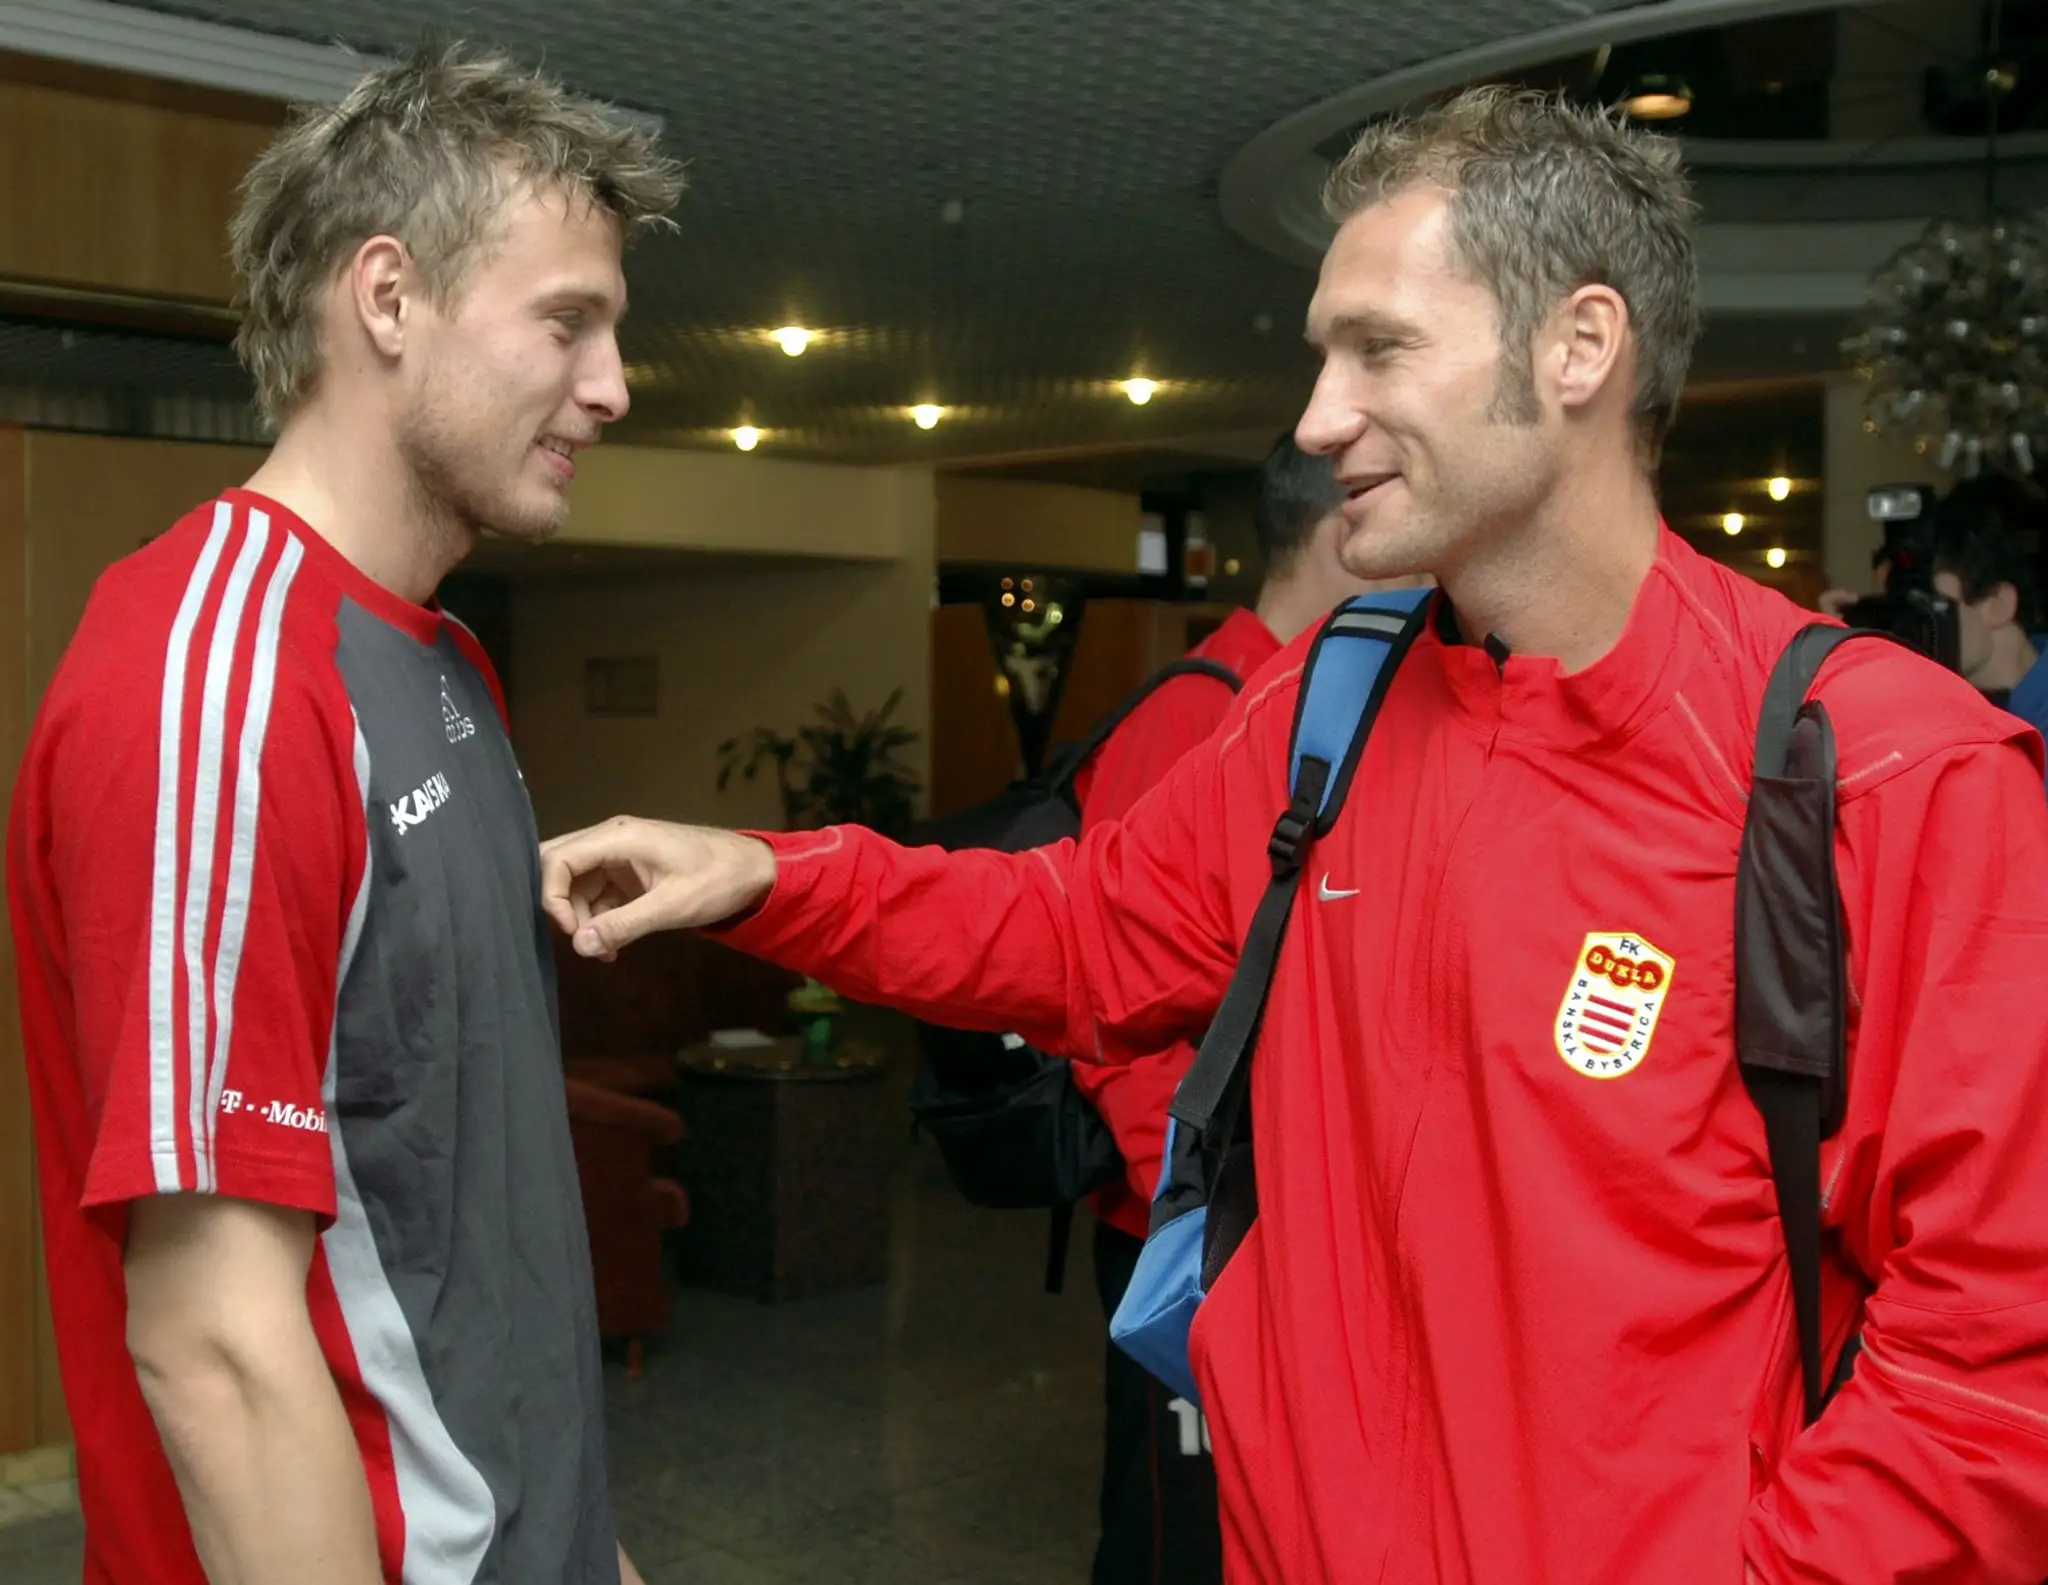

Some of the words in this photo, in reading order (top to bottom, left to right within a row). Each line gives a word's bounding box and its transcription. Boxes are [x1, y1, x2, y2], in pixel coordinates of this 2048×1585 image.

[1590, 952, 1656, 983] DUKLA
[1619, 937, 1640, 955] FK
[1585, 1002, 1654, 1069] BYSTRICA
[1167, 1396, 1212, 1455] 1
